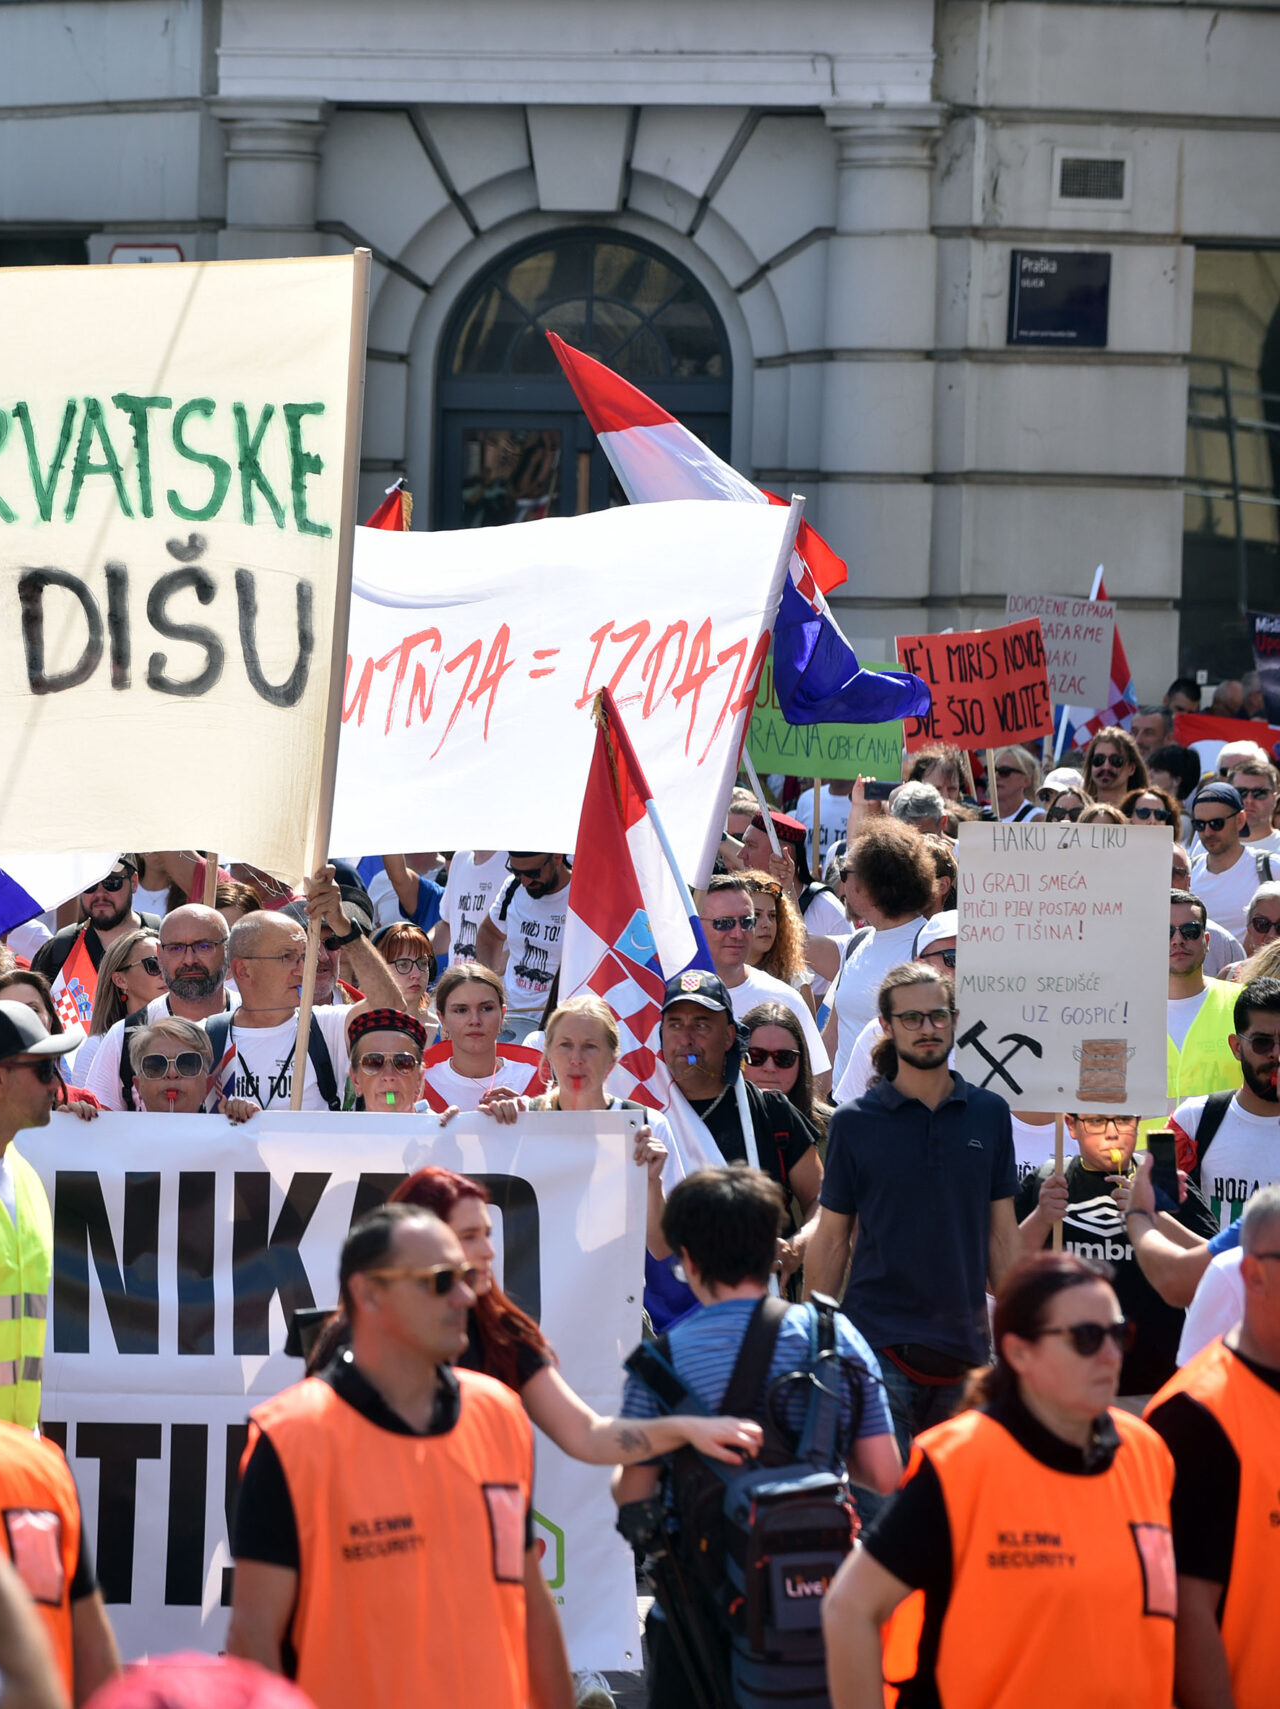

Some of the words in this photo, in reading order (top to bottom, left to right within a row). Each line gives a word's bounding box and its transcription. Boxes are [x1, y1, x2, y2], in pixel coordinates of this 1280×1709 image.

[1021, 256, 1057, 273] Praška
[19, 533, 316, 709] DIŠU
[1072, 601, 1114, 620] OTPADA
[946, 641, 998, 684] MIRIS
[1003, 629, 1047, 675] NOVCA
[341, 622, 516, 761] UTNJA
[947, 695, 985, 736] ŠTO
[993, 681, 1051, 733] VOLITE?
[749, 715, 824, 760] RAZNA
[827, 734, 903, 763] OBEĆANJA
[993, 826, 1047, 852] HAIKU
[1057, 826, 1081, 849] ZA
[1091, 827, 1128, 849] LIKU
[962, 872, 975, 895] U
[982, 872, 1031, 893] GRAJI
[1038, 870, 1088, 893] SMEĆA
[1004, 900, 1034, 918] PJEV
[1039, 901, 1087, 916] POSTAO
[1092, 902, 1124, 916] NAM
[959, 924, 1006, 943] SAMO
[959, 975, 1027, 994] MURSKO
[1036, 972, 1101, 993] SREDIŠĆE
[1021, 1004, 1049, 1023] UZ
[1066, 1239, 1135, 1261] umbr
[349, 1515, 414, 1538] KLEMM
[342, 1535, 426, 1563] SECURITY
[997, 1529, 1062, 1547] KLEMM
[987, 1551, 1076, 1570] SECURITY
